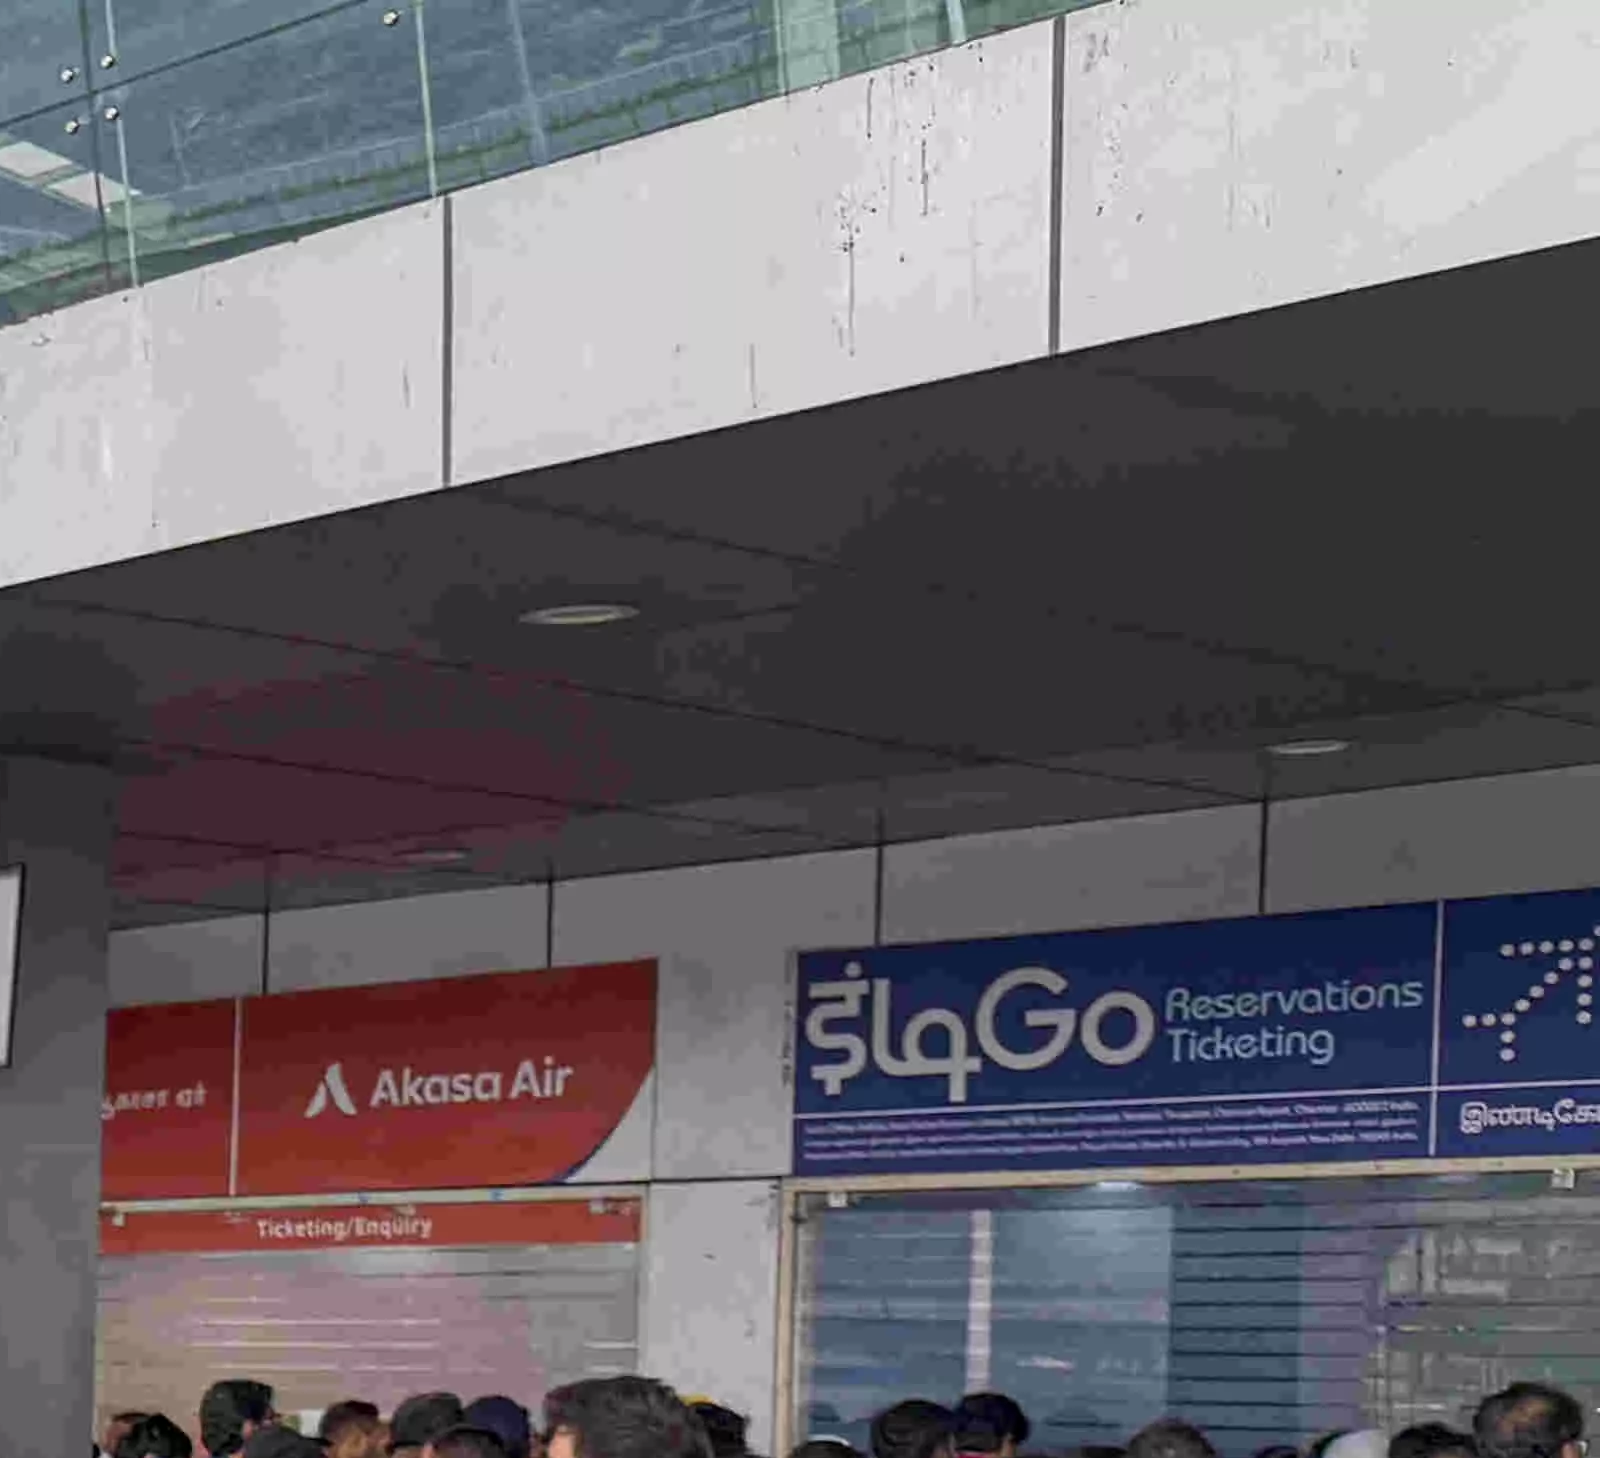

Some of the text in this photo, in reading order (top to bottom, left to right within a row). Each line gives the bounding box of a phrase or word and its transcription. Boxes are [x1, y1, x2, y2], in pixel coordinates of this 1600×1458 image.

[1165, 976, 1424, 1022] Reservations
[1167, 1025, 1335, 1065] Ticketing
[369, 1055, 573, 1108] Akasa Air
[257, 1215, 434, 1242] Ticketing/Enquiry
